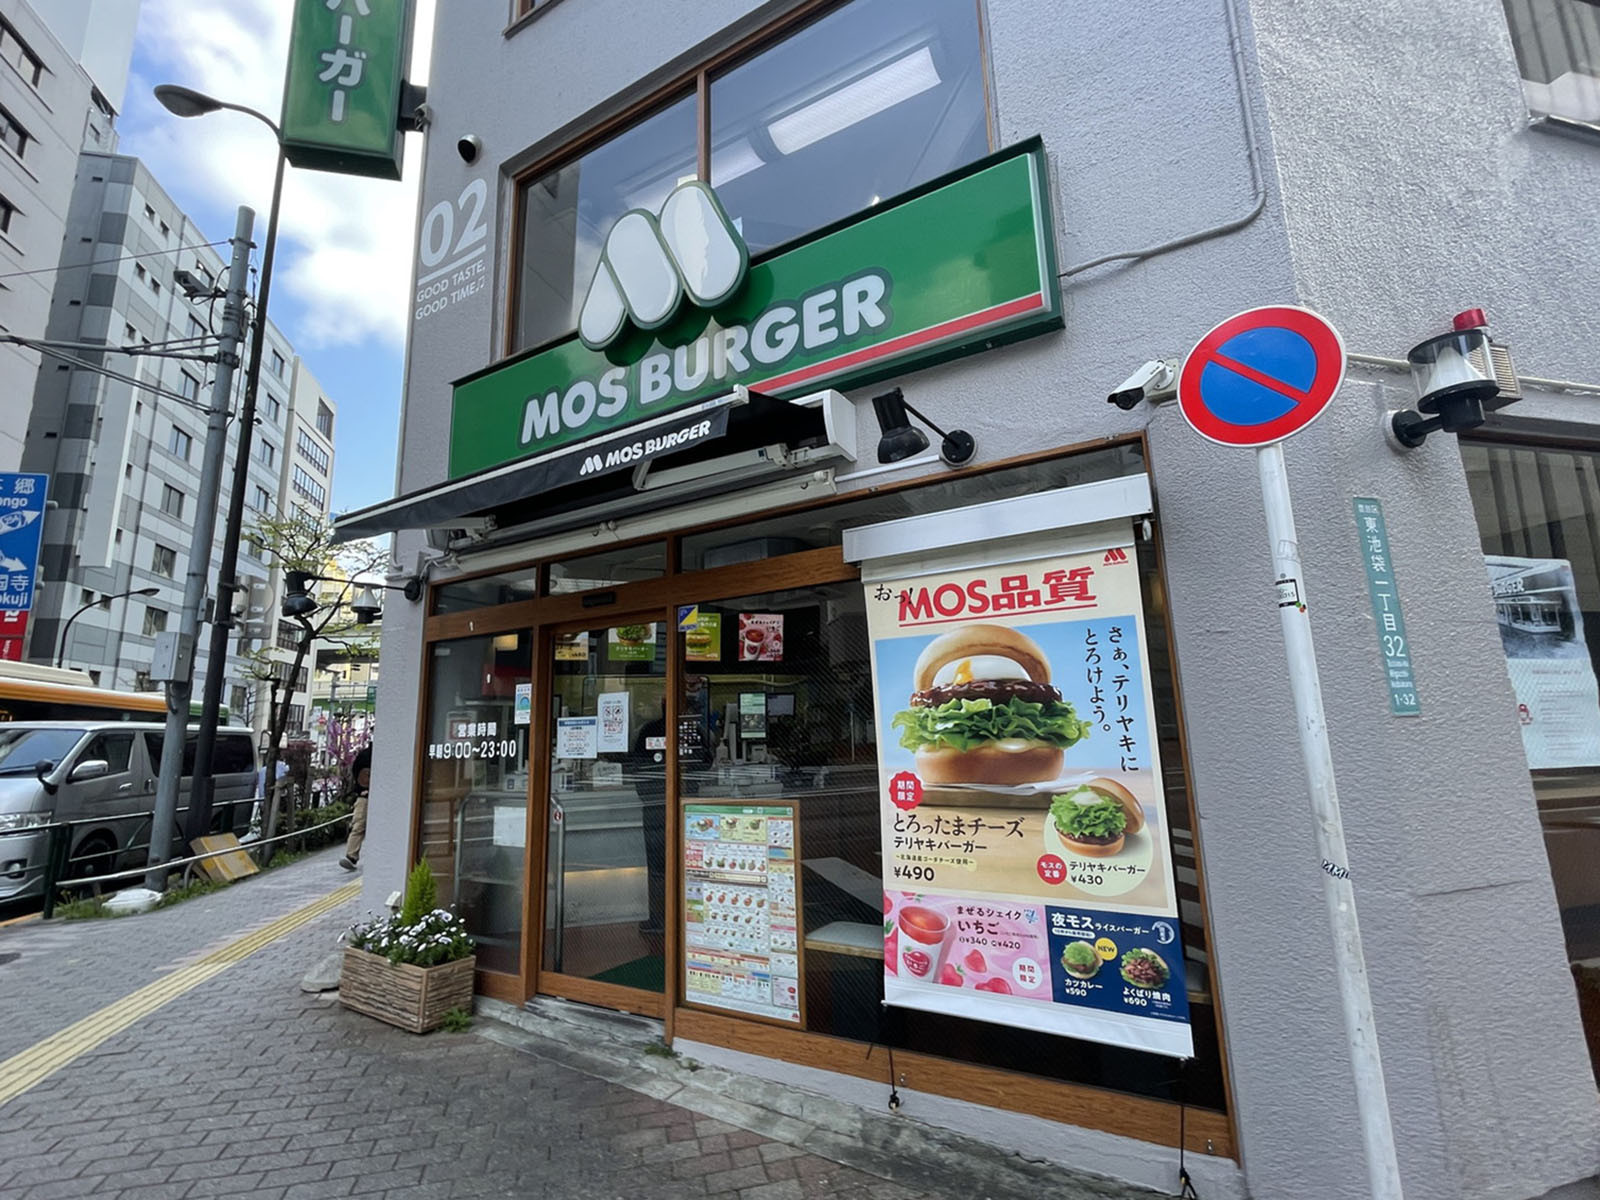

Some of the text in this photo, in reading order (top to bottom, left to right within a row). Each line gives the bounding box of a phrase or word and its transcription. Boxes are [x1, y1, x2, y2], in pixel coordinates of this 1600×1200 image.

[420, 178, 487, 267] 02
[417, 279, 449, 302] GOOD
[415, 297, 448, 320] GOOD
[521, 273, 886, 445] MOS BURGER
[605, 420, 711, 467] MOS BURGER
[0, 478, 35, 495] 郷
[0, 592, 28, 607] kuji
[898, 566, 1097, 622] MOS品質
[1383, 635, 1406, 657] 32
[1085, 628, 1111, 732] とろけよう。
[458, 721, 497, 738] 営業時間
[897, 780, 915, 790] 期間
[897, 791, 915, 802] 限定
[893, 813, 1025, 838] とろったまチーズ
[894, 836, 988, 853] テリヤキバーガー
[894, 865, 935, 881] ¥490
[1040, 861, 1063, 870] モスの
[1069, 860, 1146, 875] テリヤキバーガー
[1070, 874, 1104, 885] ¥430
[956, 906, 1022, 920] まぜるシェイク
[958, 919, 1000, 935] いちご
[1051, 912, 1095, 930] 夜モス
[1095, 923, 1150, 935] ライスバーガー
[1097, 946, 1116, 954] NEW
[1019, 964, 1035, 973] 期間
[1065, 987, 1087, 997] ¥590
